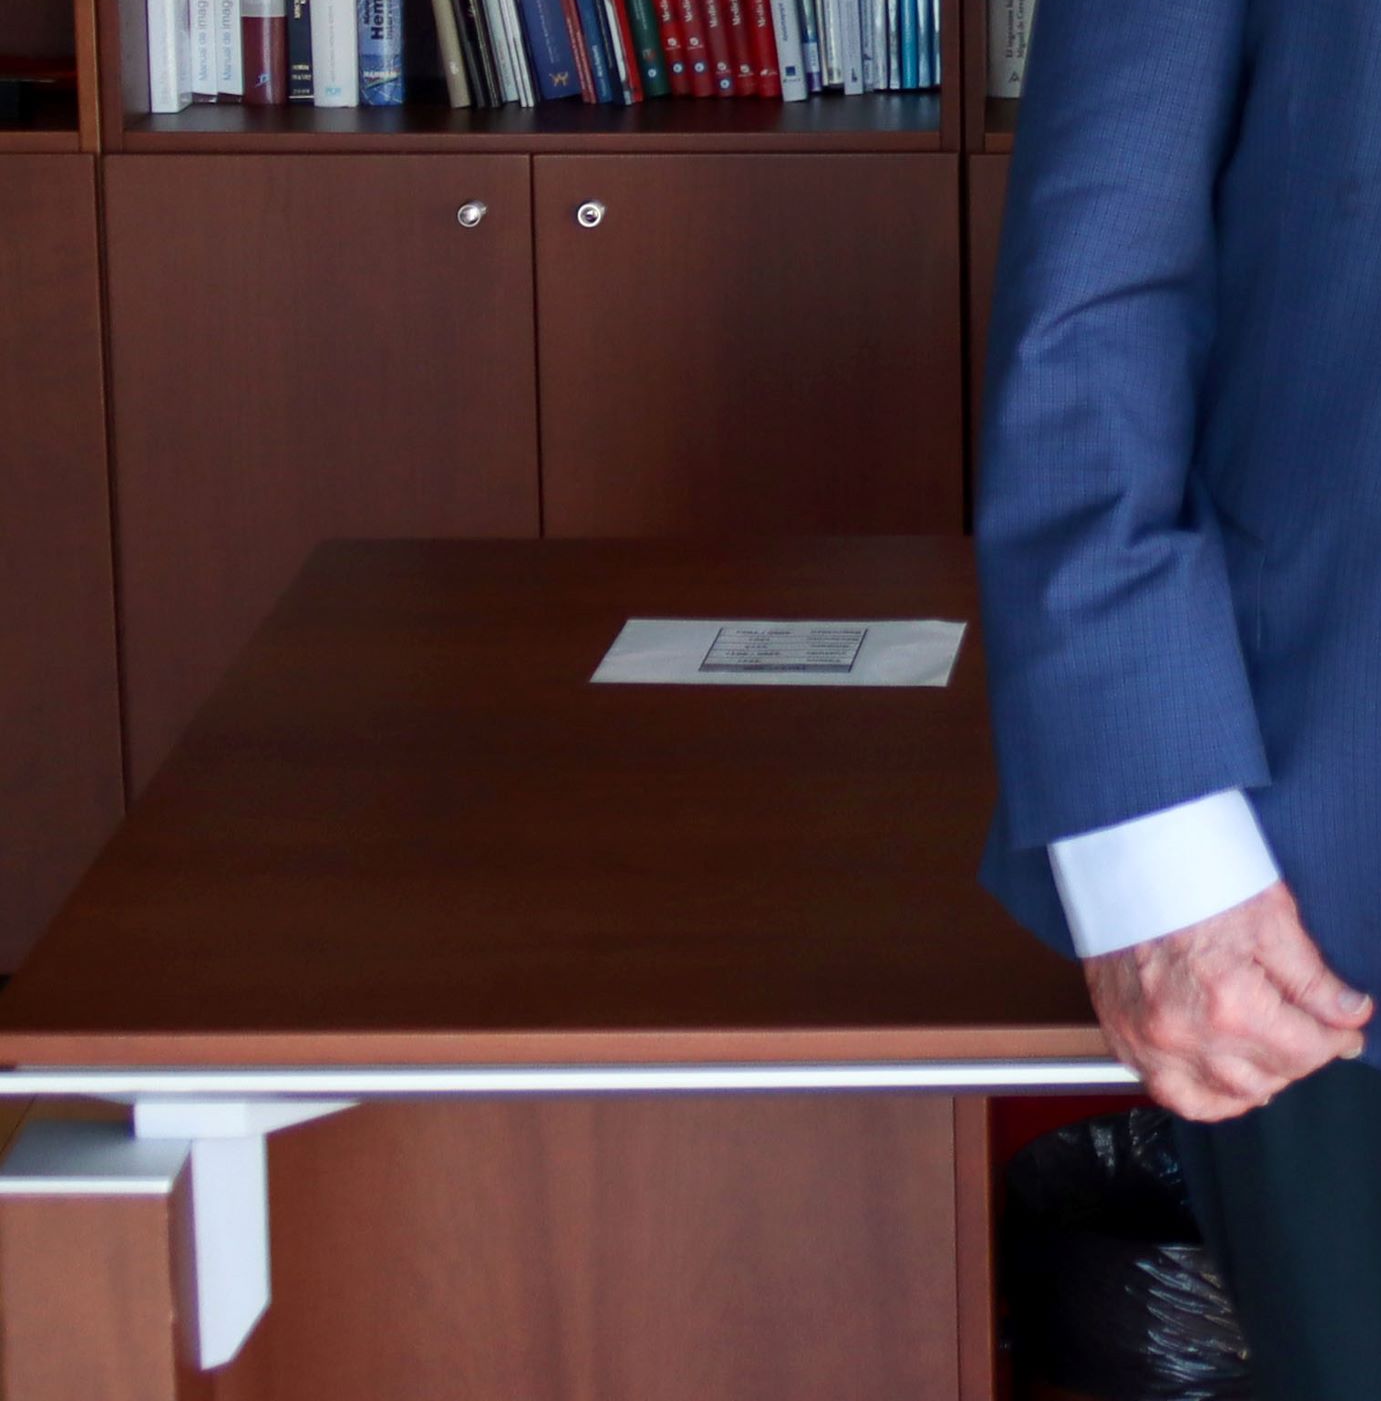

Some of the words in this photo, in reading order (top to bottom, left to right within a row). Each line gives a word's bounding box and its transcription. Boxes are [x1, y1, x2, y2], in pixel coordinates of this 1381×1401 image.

[197, 31, 206, 45] de
[222, 32, 231, 45] de
[197, 47, 207, 80] Manual
[222, 47, 232, 80] Manual
